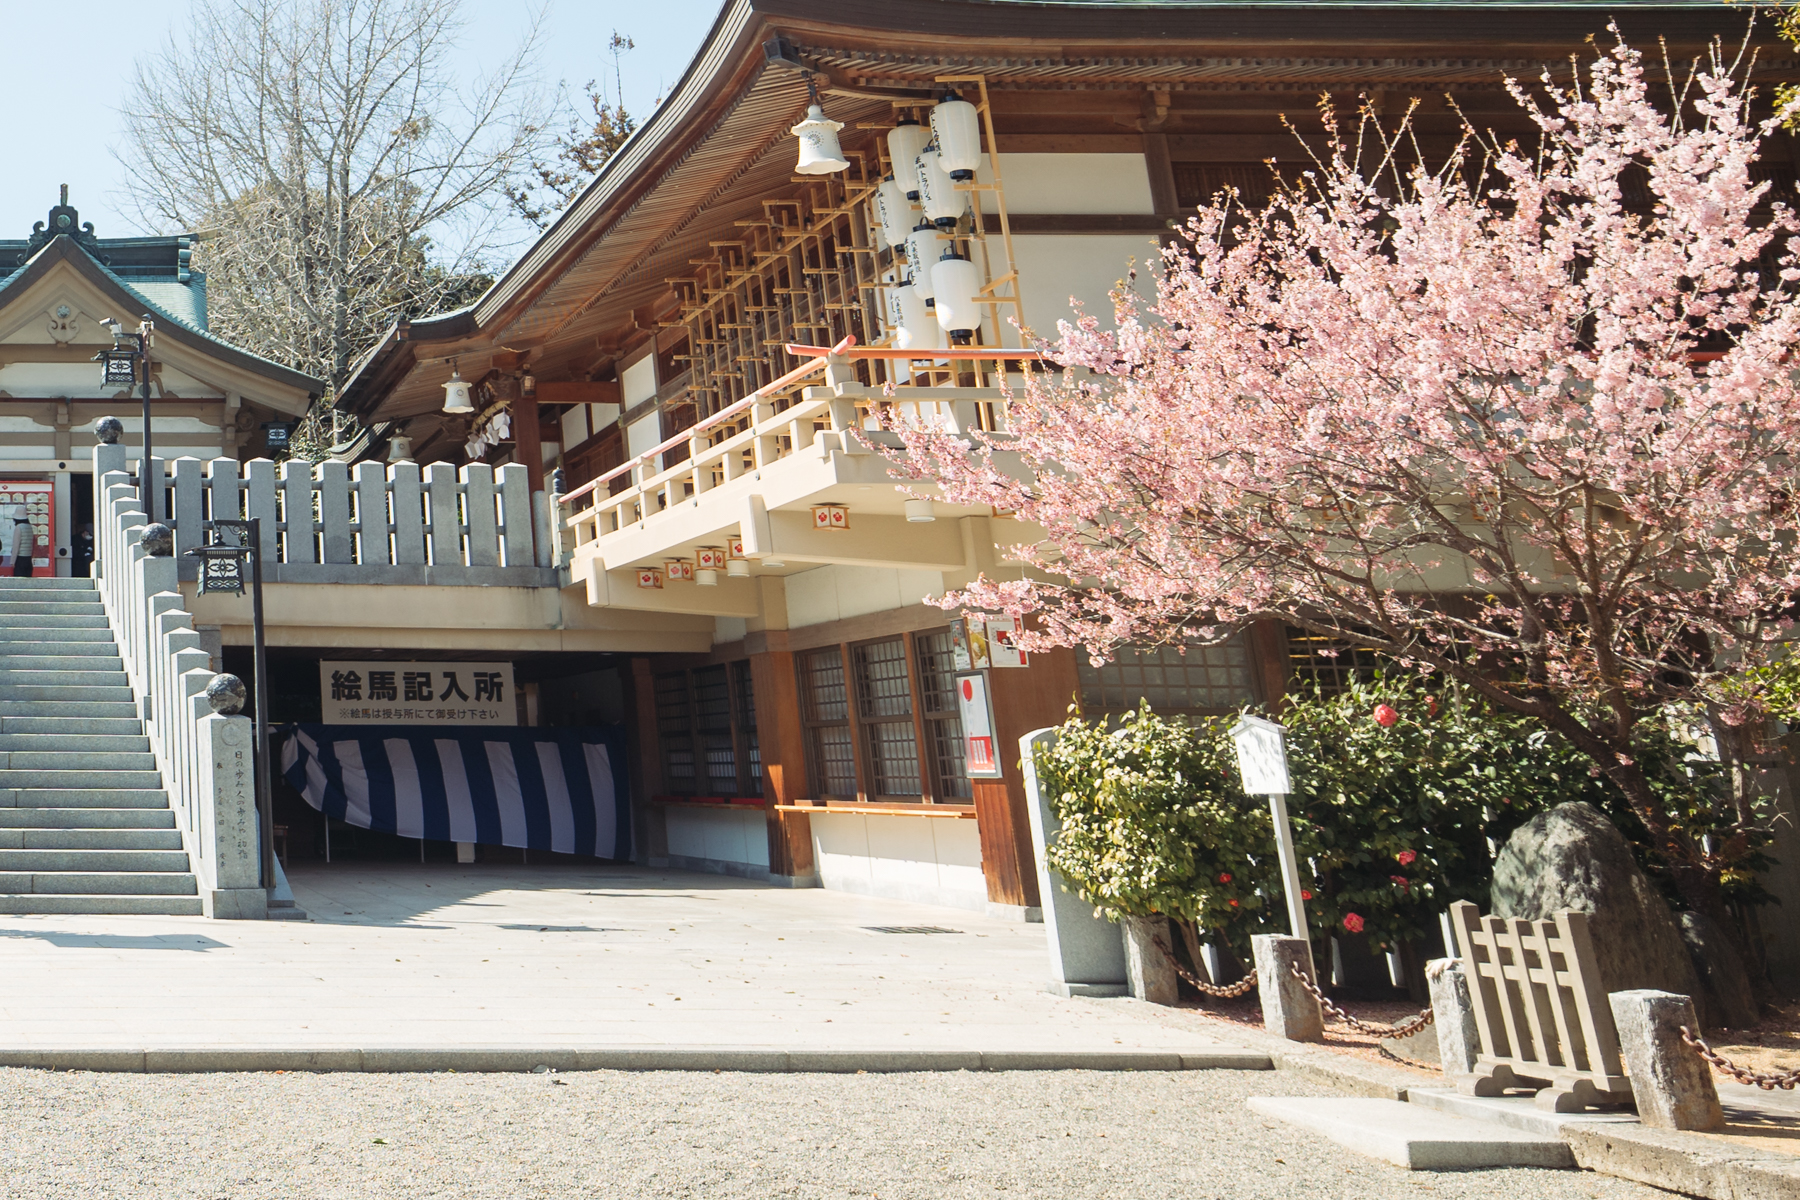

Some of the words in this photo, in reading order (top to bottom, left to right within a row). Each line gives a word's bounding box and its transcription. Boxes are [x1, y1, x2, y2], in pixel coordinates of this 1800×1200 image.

[331, 670, 504, 702] 絵馬記入所
